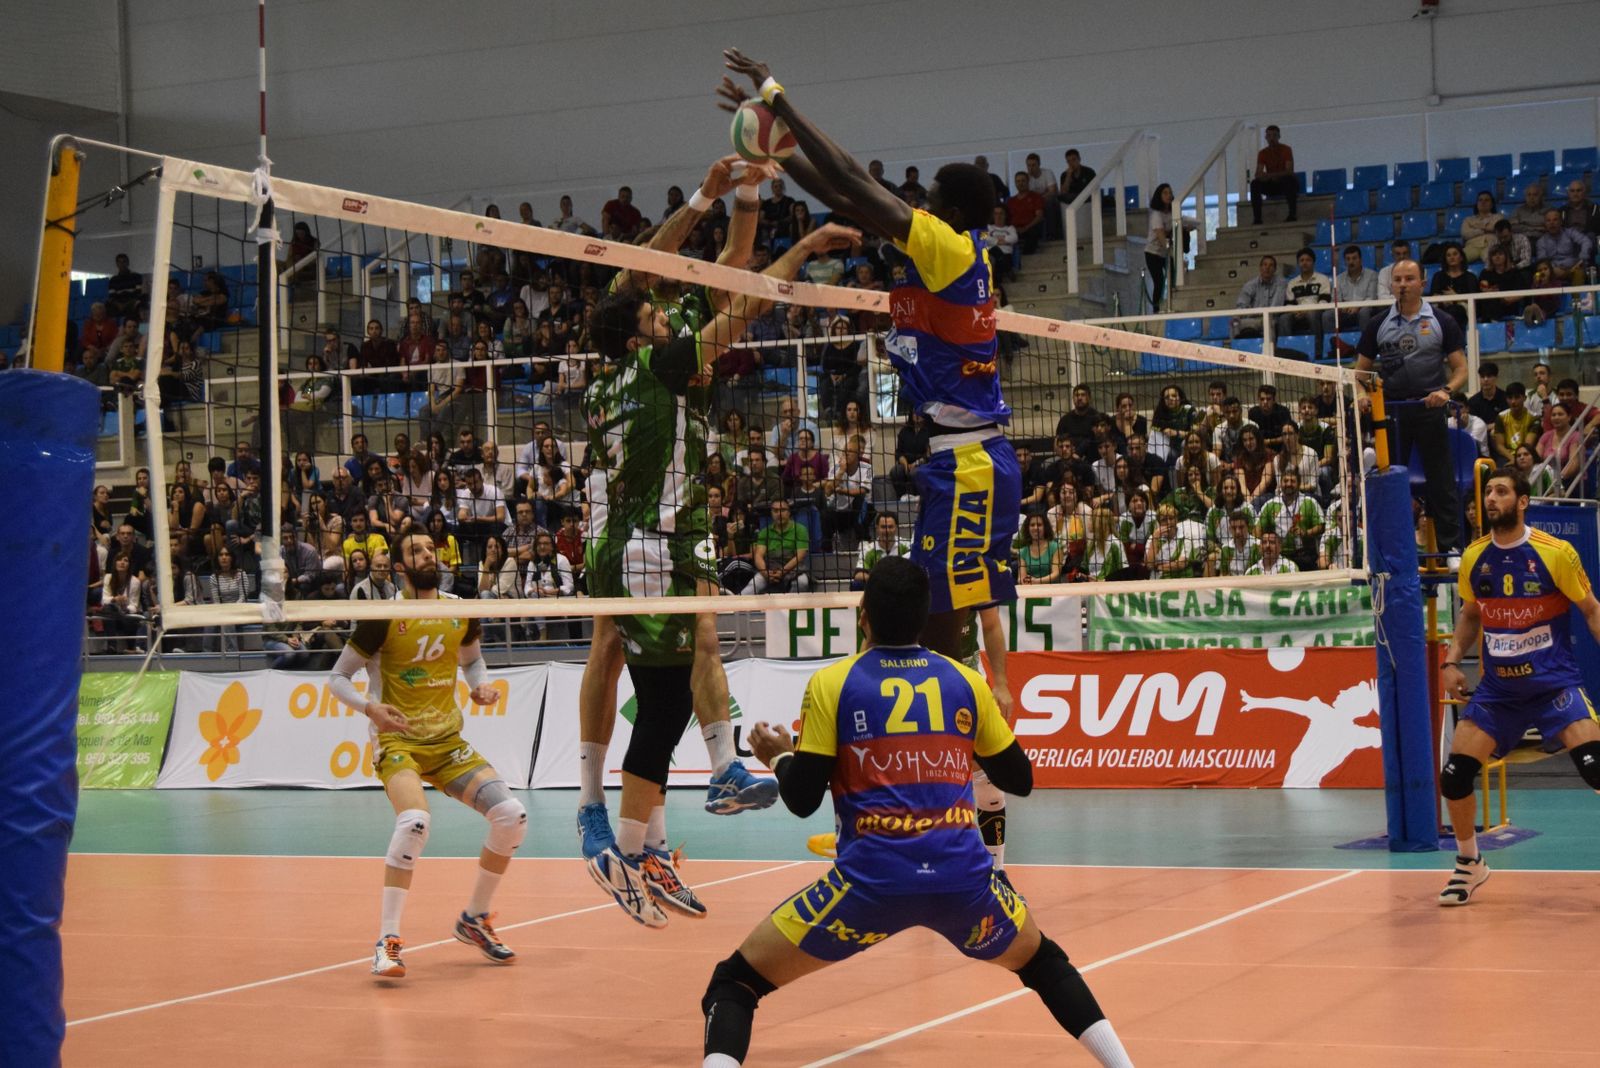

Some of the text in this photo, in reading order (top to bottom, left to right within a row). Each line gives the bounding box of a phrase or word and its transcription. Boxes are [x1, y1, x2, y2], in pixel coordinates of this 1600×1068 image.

[952, 490, 989, 585] IBIZA
[1503, 574, 1514, 595] 8
[412, 634, 446, 663] 16
[880, 658, 928, 668] SALERNO
[880, 677, 945, 734] 21
[1014, 671, 1227, 737] SVM
[133, 733, 154, 746] Mar
[1024, 748, 1276, 768] PERLIGA VOLEIBOL MASCULINA
